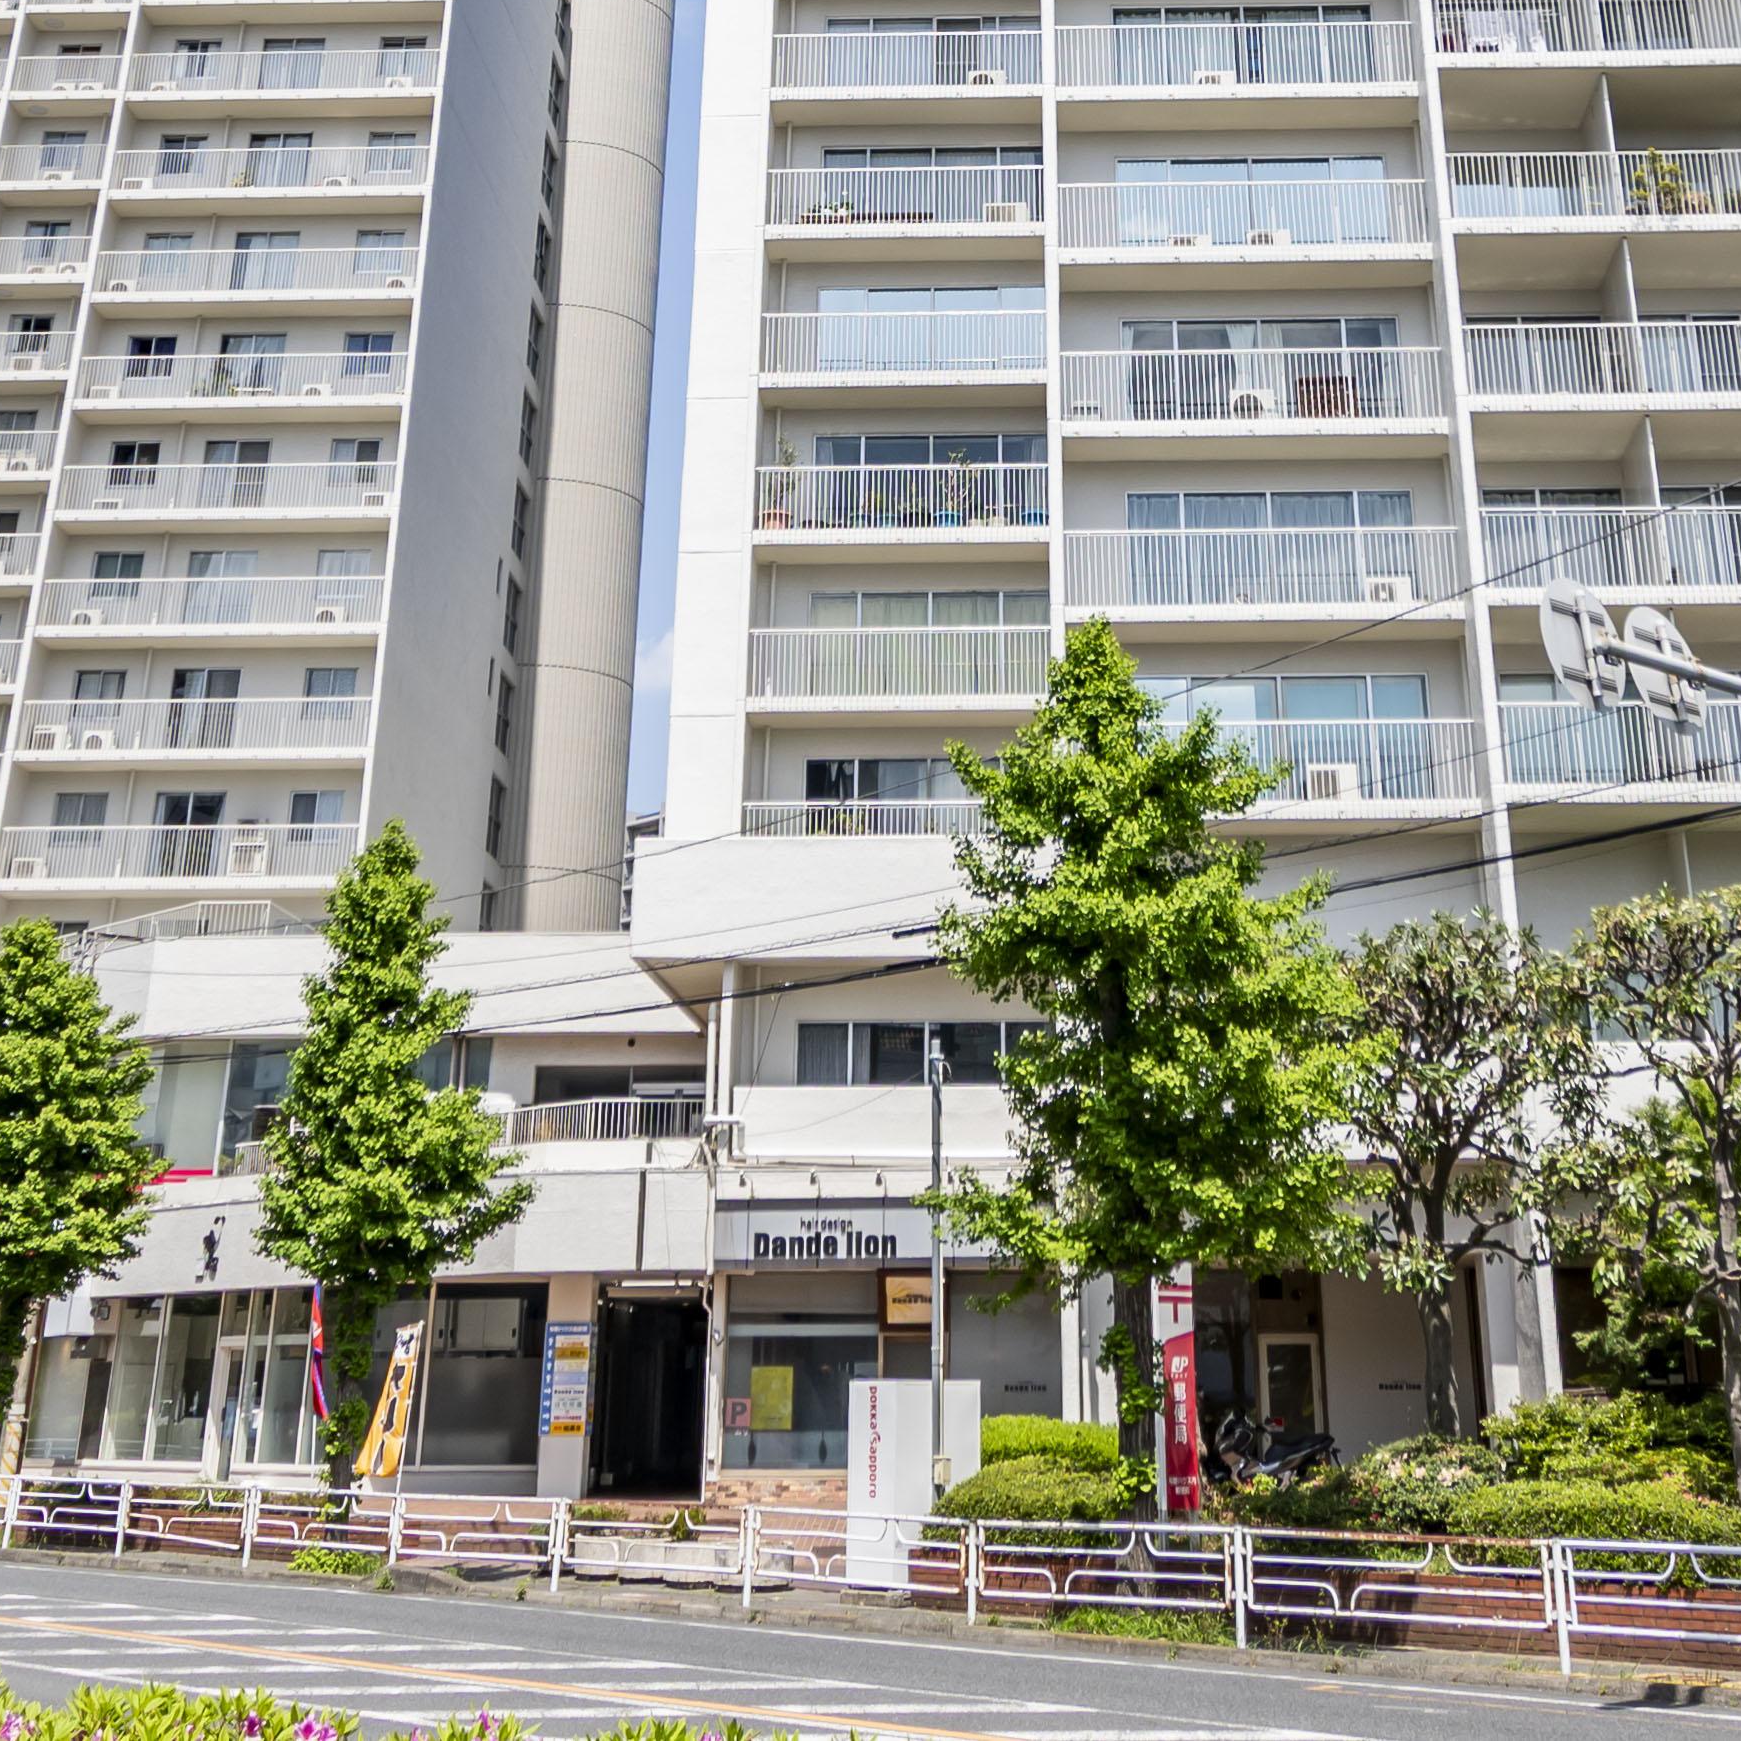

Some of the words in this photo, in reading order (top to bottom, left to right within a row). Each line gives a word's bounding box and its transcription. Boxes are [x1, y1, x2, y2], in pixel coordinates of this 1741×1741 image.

[731, 1402, 747, 1425] P
[1173, 1382, 1187, 1445] 郵便局
